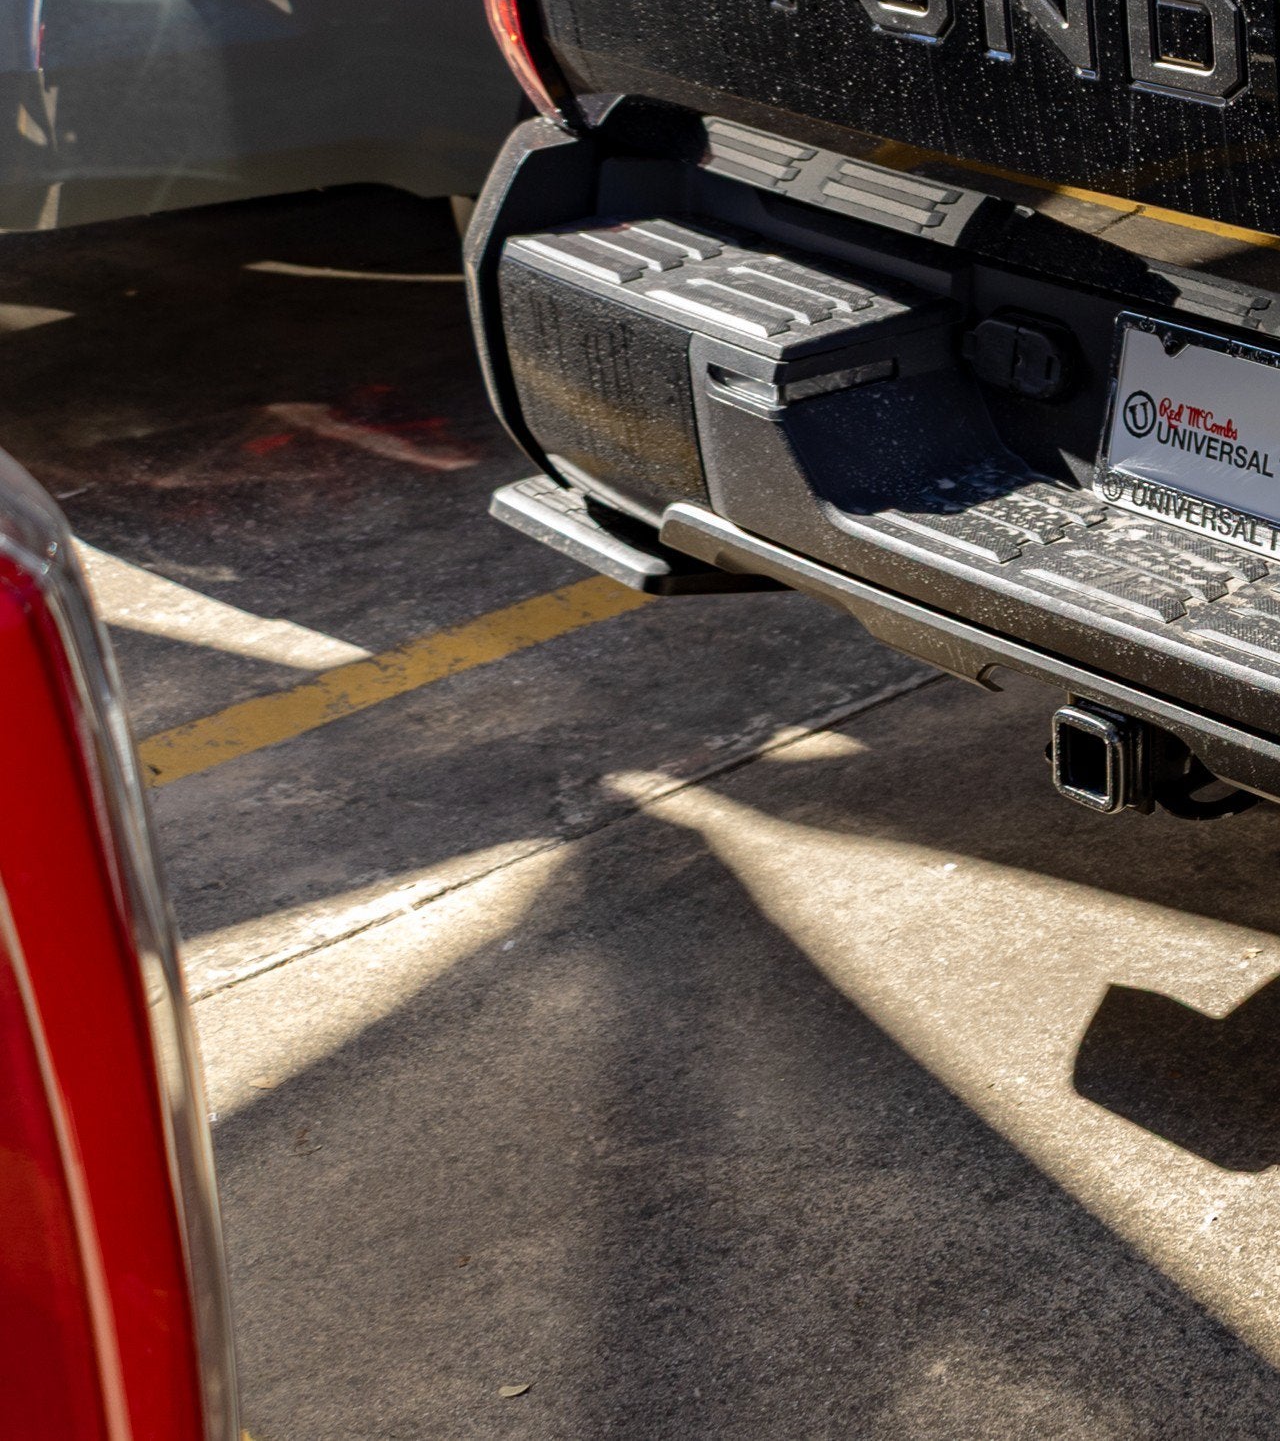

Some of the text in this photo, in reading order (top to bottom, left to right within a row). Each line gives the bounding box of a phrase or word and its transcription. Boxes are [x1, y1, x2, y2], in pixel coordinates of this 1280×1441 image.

[1159, 397, 1238, 440] Red McCombs
[1156, 421, 1274, 478] UNIVERSAL
[1131, 479, 1264, 546] UNIVERSAL
